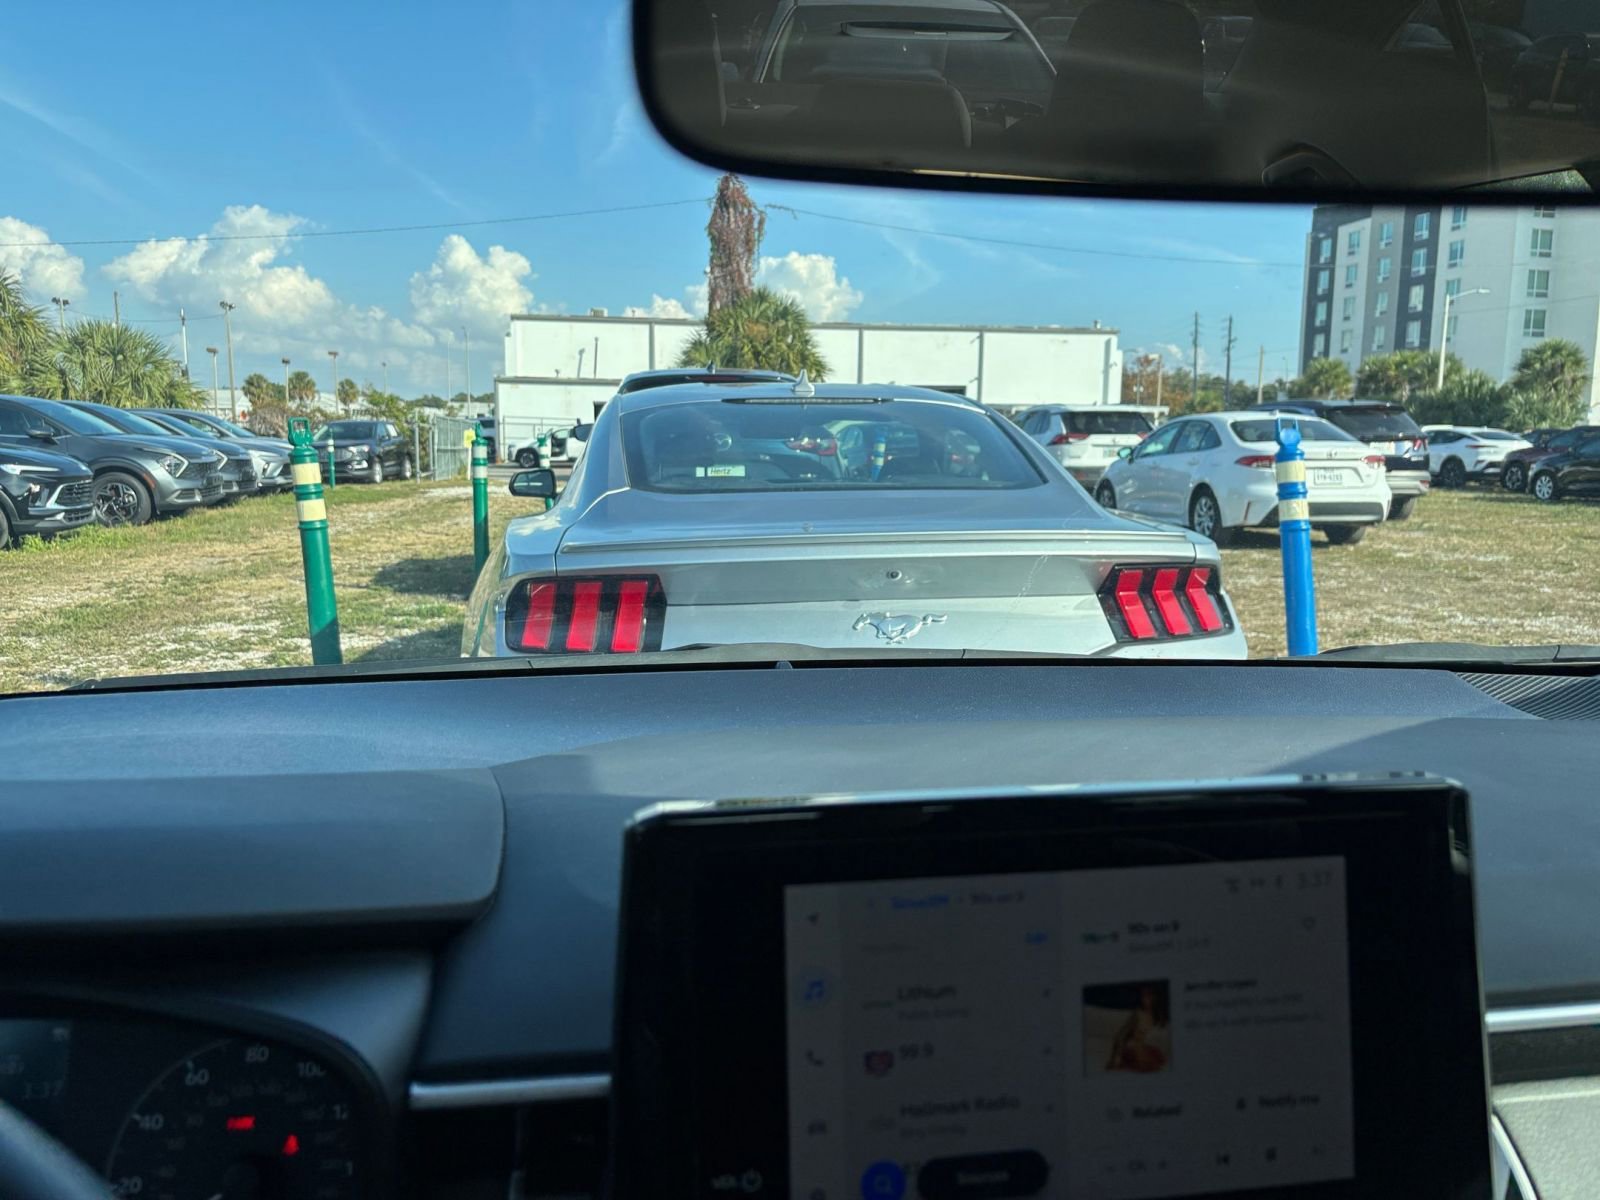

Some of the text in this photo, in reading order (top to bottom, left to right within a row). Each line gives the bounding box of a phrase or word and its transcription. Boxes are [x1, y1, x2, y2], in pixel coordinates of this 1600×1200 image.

[244, 1045, 270, 1063] 80
[185, 1067, 210, 1086] 60
[140, 1112, 165, 1130] 40
[119, 1175, 143, 1194] 20
